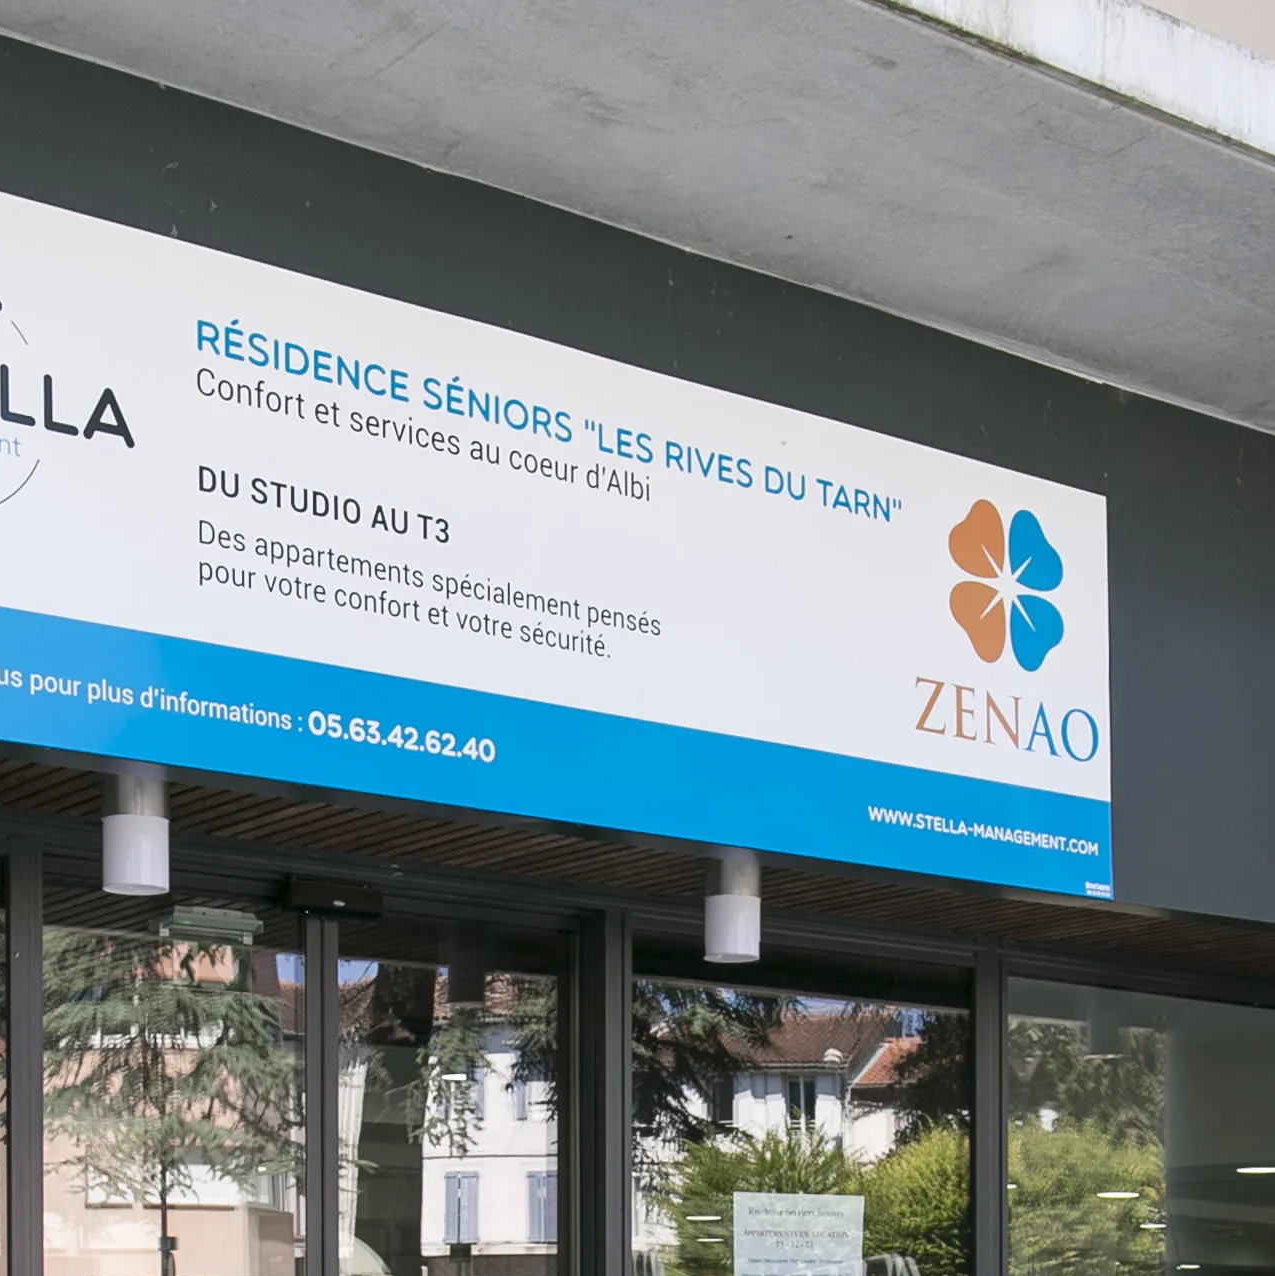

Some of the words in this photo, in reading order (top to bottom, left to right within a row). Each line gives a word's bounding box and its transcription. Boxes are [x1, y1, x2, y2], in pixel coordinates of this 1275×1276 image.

[196, 368, 305, 419] Confort
[314, 402, 340, 427] et
[349, 417, 460, 455] services
[469, 440, 500, 465] au
[509, 449, 578, 484] coeur
[586, 463, 651, 502] d'Albi
[197, 318, 409, 402] RÉSIDENCE
[423, 376, 572, 443] SÉNIORS
[584, 419, 654, 463] "LES
[666, 441, 753, 488] RIVES
[765, 466, 805, 500] DU
[816, 479, 902, 522] TARN"
[198, 465, 239, 499] DU
[250, 477, 361, 525] STUDIO
[371, 504, 408, 535] AU
[417, 513, 451, 544] T3
[198, 520, 246, 552] Des
[254, 534, 424, 588] appartements
[432, 571, 581, 620] spécialement
[587, 602, 662, 637] pensés
[198, 560, 256, 590] pour
[265, 571, 326, 603] votre
[334, 586, 421, 623] confort
[427, 605, 449, 628] et
[456, 609, 513, 639] votre
[520, 621, 612, 659] sécurité.
[29, 669, 81, 698] pour
[87, 678, 134, 707] plus
[140, 685, 292, 732] d'informations
[307, 711, 496, 764] 05.63.42.62.40
[914, 676, 1099, 762] ZENAO
[868, 805, 1099, 857] WWW.STELLA-MANAGEMENT.COM
